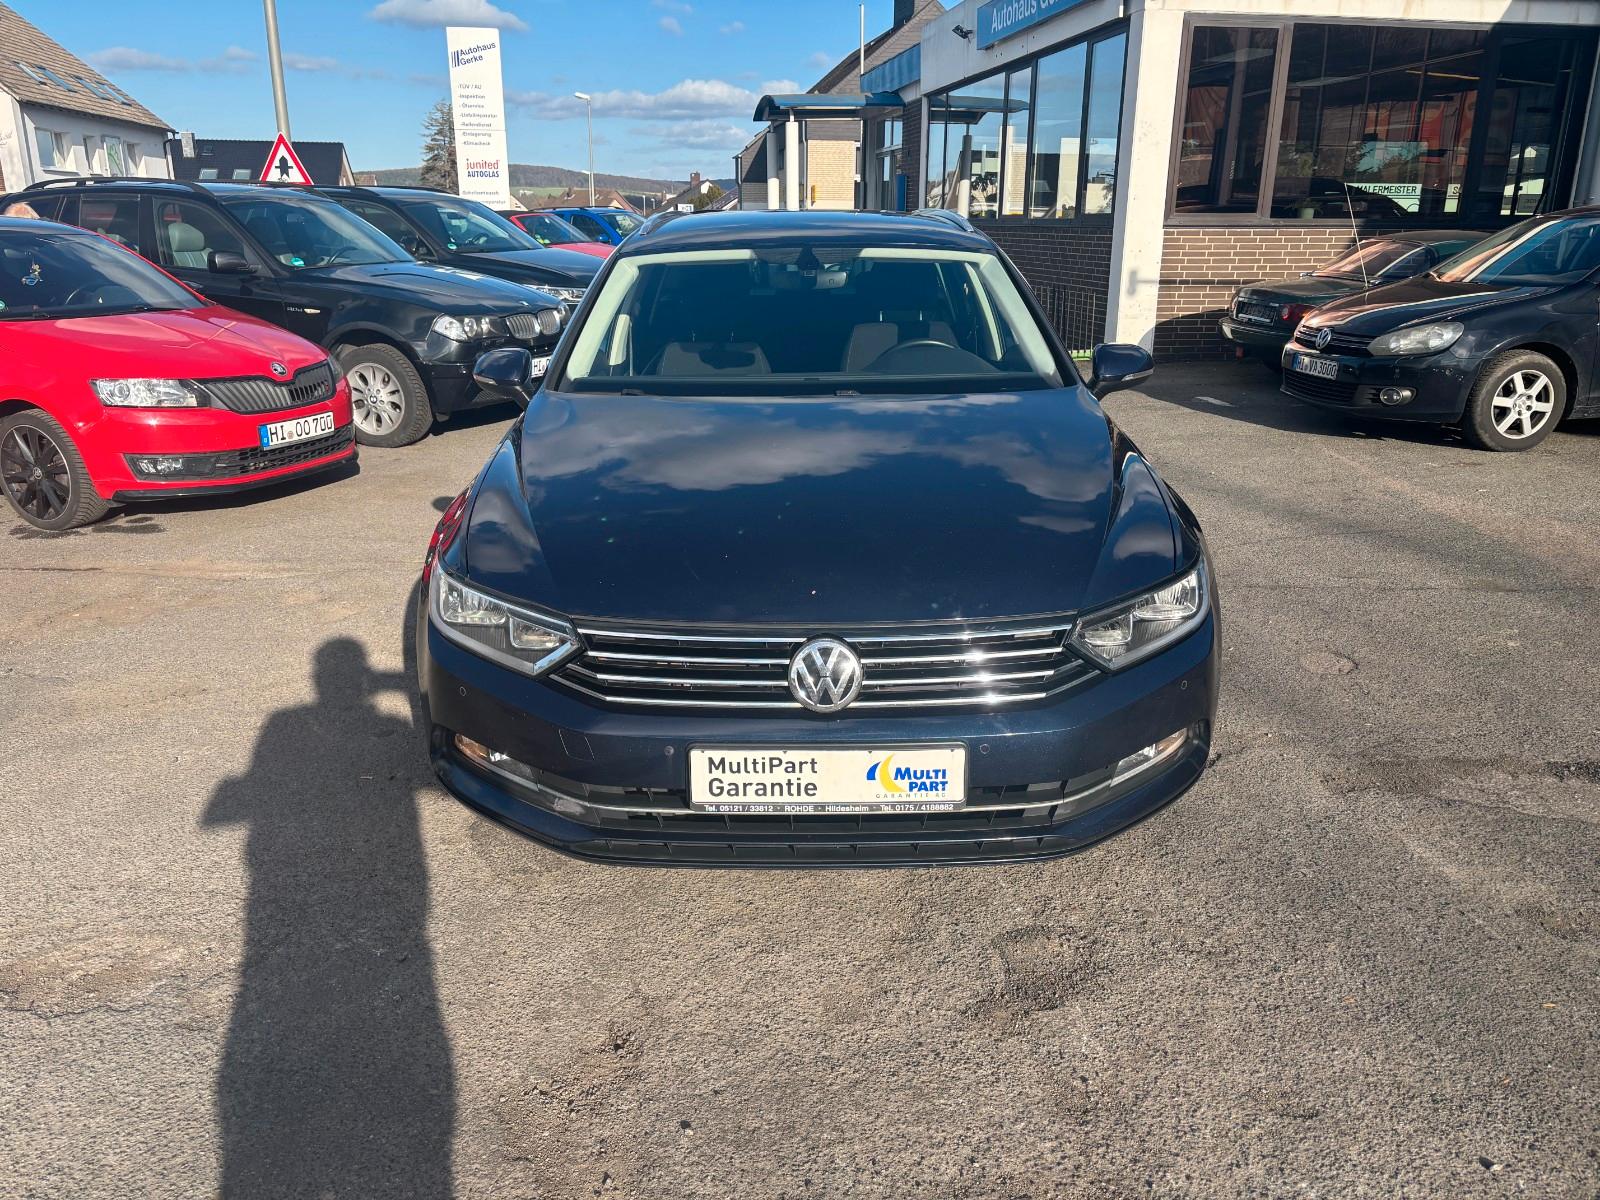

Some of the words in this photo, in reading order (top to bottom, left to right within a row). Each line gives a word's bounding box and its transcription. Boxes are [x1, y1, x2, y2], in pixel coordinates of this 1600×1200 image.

[992, 0, 1037, 33] Autohaus
[460, 42, 496, 56] Autohaus
[460, 54, 483, 65] Gerke
[466, 158, 500, 170] junited
[467, 170, 500, 178] AUTOGLAS
[269, 425, 286, 442] HI
[707, 756, 818, 774] MultiPart
[894, 766, 947, 781] MULTI
[708, 777, 818, 798] Garantie
[908, 780, 949, 793] PART
[704, 804, 718, 812] Tel.
[719, 804, 743, 812] 05121
[784, 804, 815, 812] ROHDE
[825, 804, 869, 812] Hildesheim
[880, 804, 894, 812] Tel.
[895, 803, 915, 811] 0175
